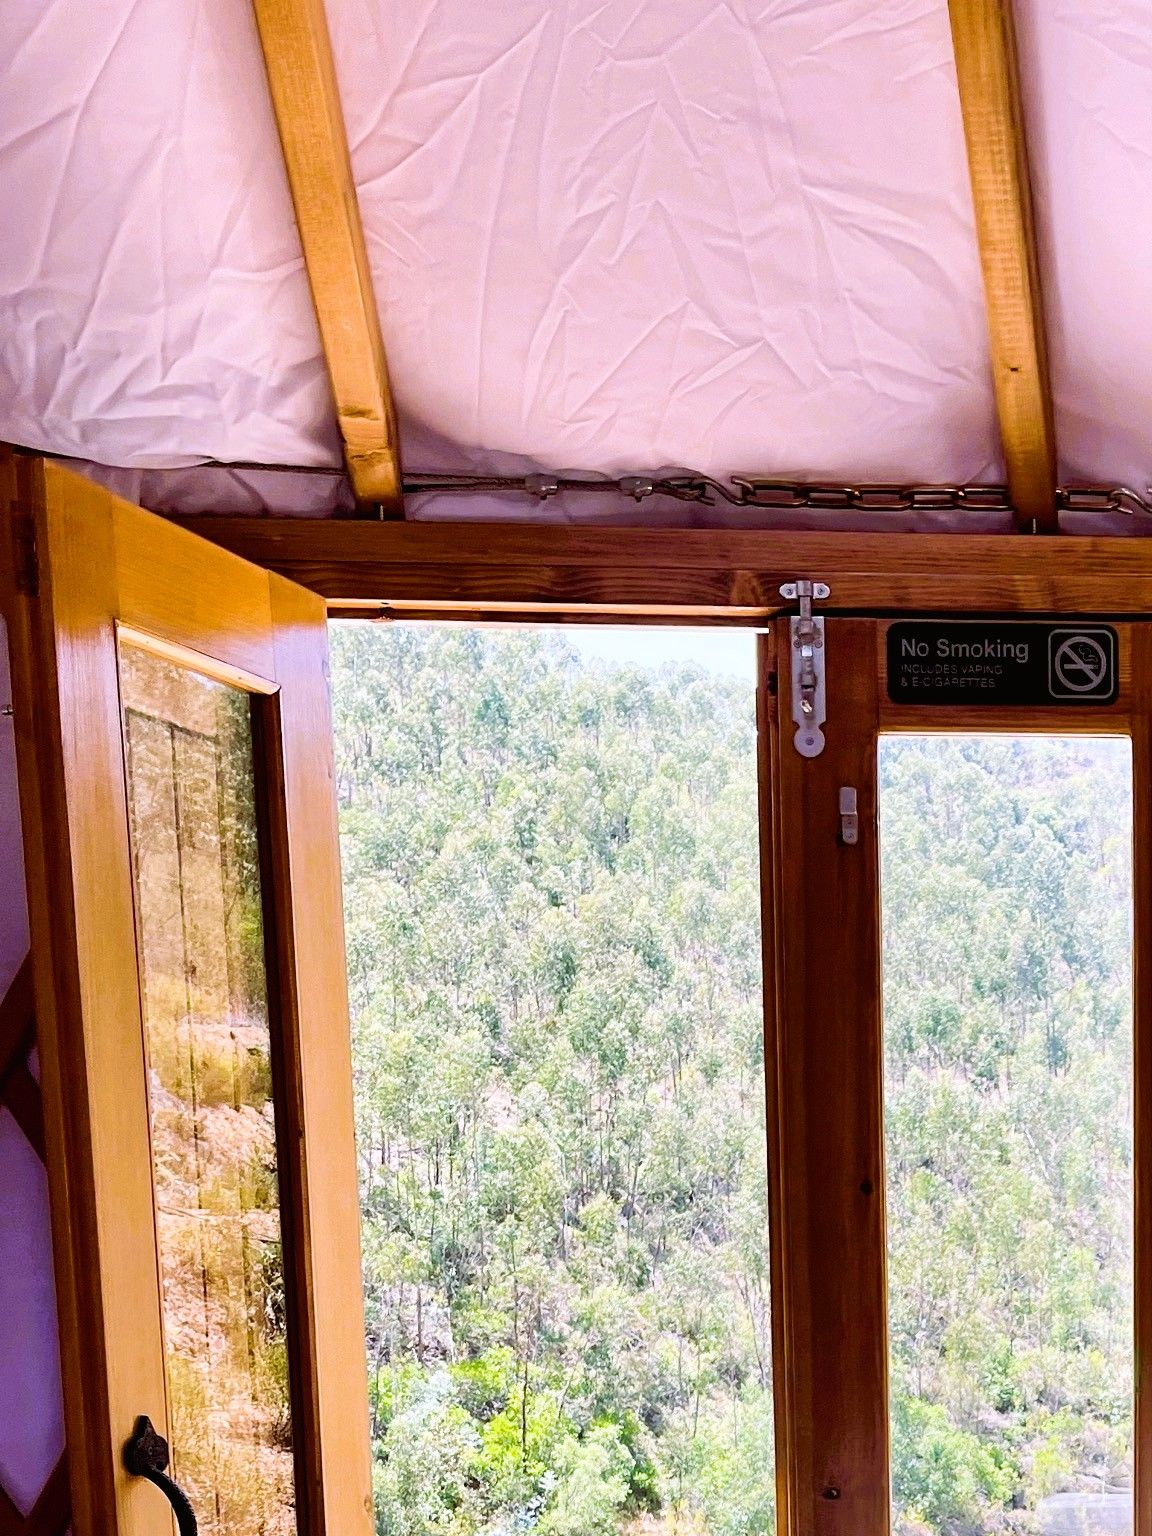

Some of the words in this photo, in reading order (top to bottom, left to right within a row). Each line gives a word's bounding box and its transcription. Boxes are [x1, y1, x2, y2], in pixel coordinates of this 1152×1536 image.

[901, 638, 929, 657] No
[937, 638, 1029, 663] Smoking
[901, 664, 958, 675] INCLUDES
[961, 665, 1003, 675] VAPING
